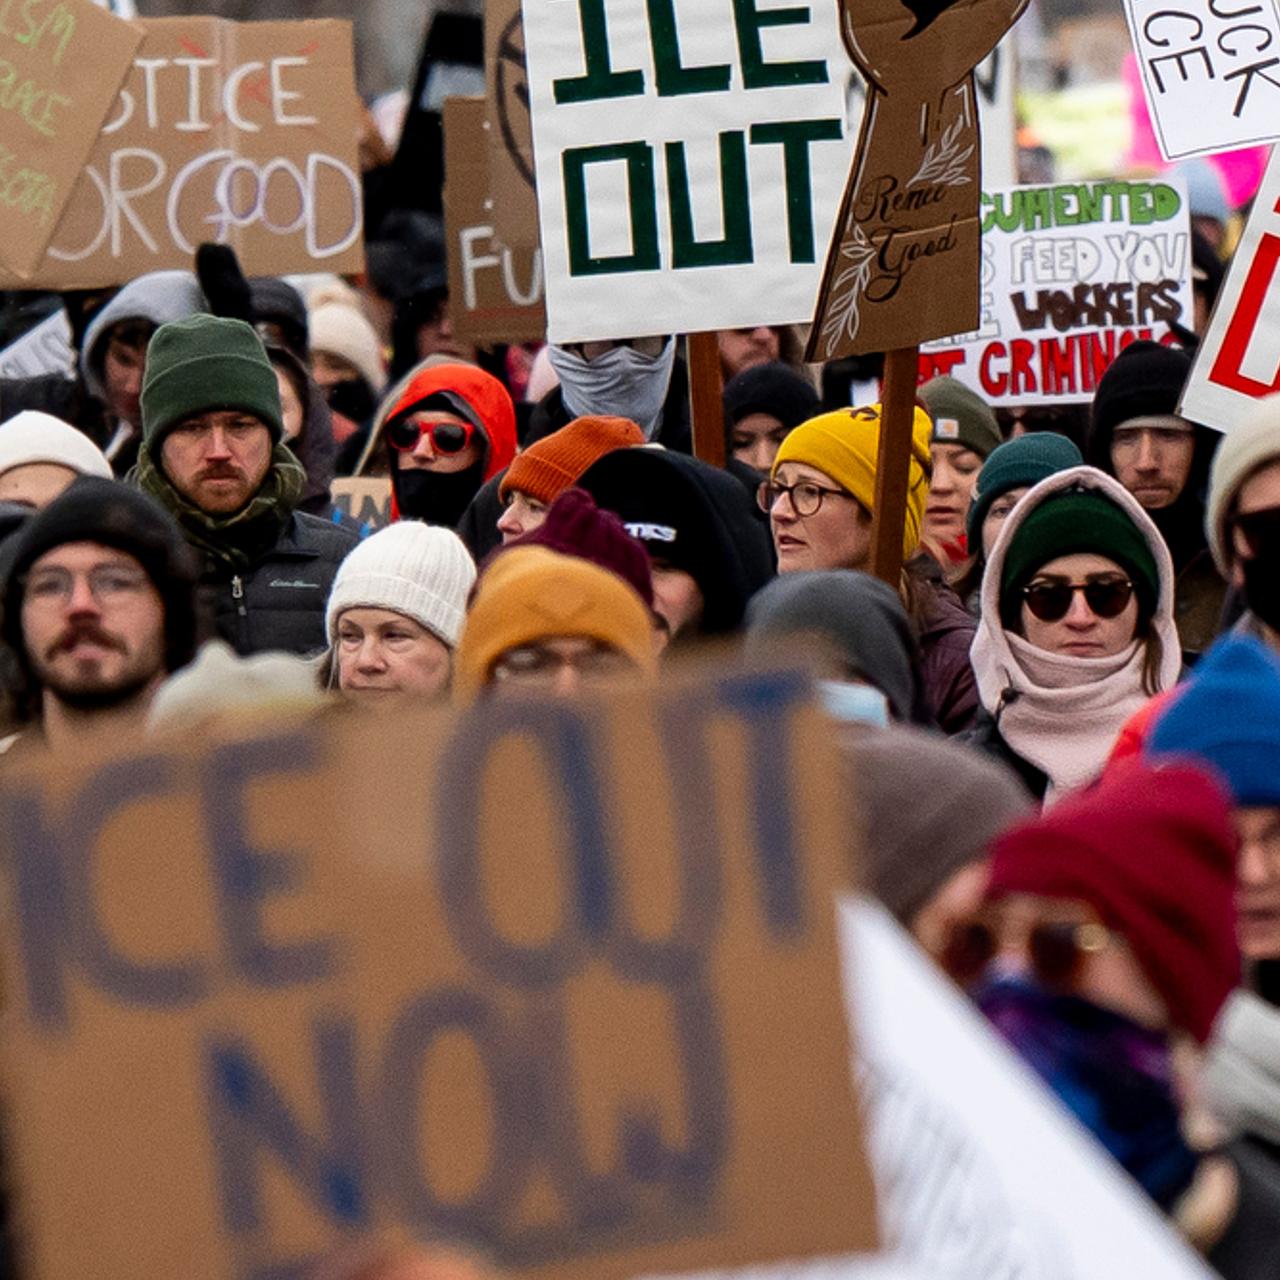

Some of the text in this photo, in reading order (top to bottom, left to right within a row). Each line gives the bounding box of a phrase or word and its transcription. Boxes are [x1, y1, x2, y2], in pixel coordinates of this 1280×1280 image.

[561, 117, 843, 277] OUT
[1010, 236, 1102, 285] FEED
[1104, 231, 1188, 285] YOU
[1010, 279, 1183, 333] WORKERS
[0, 665, 820, 1035] ICE OUT
[200, 982, 732, 1270] NOW
